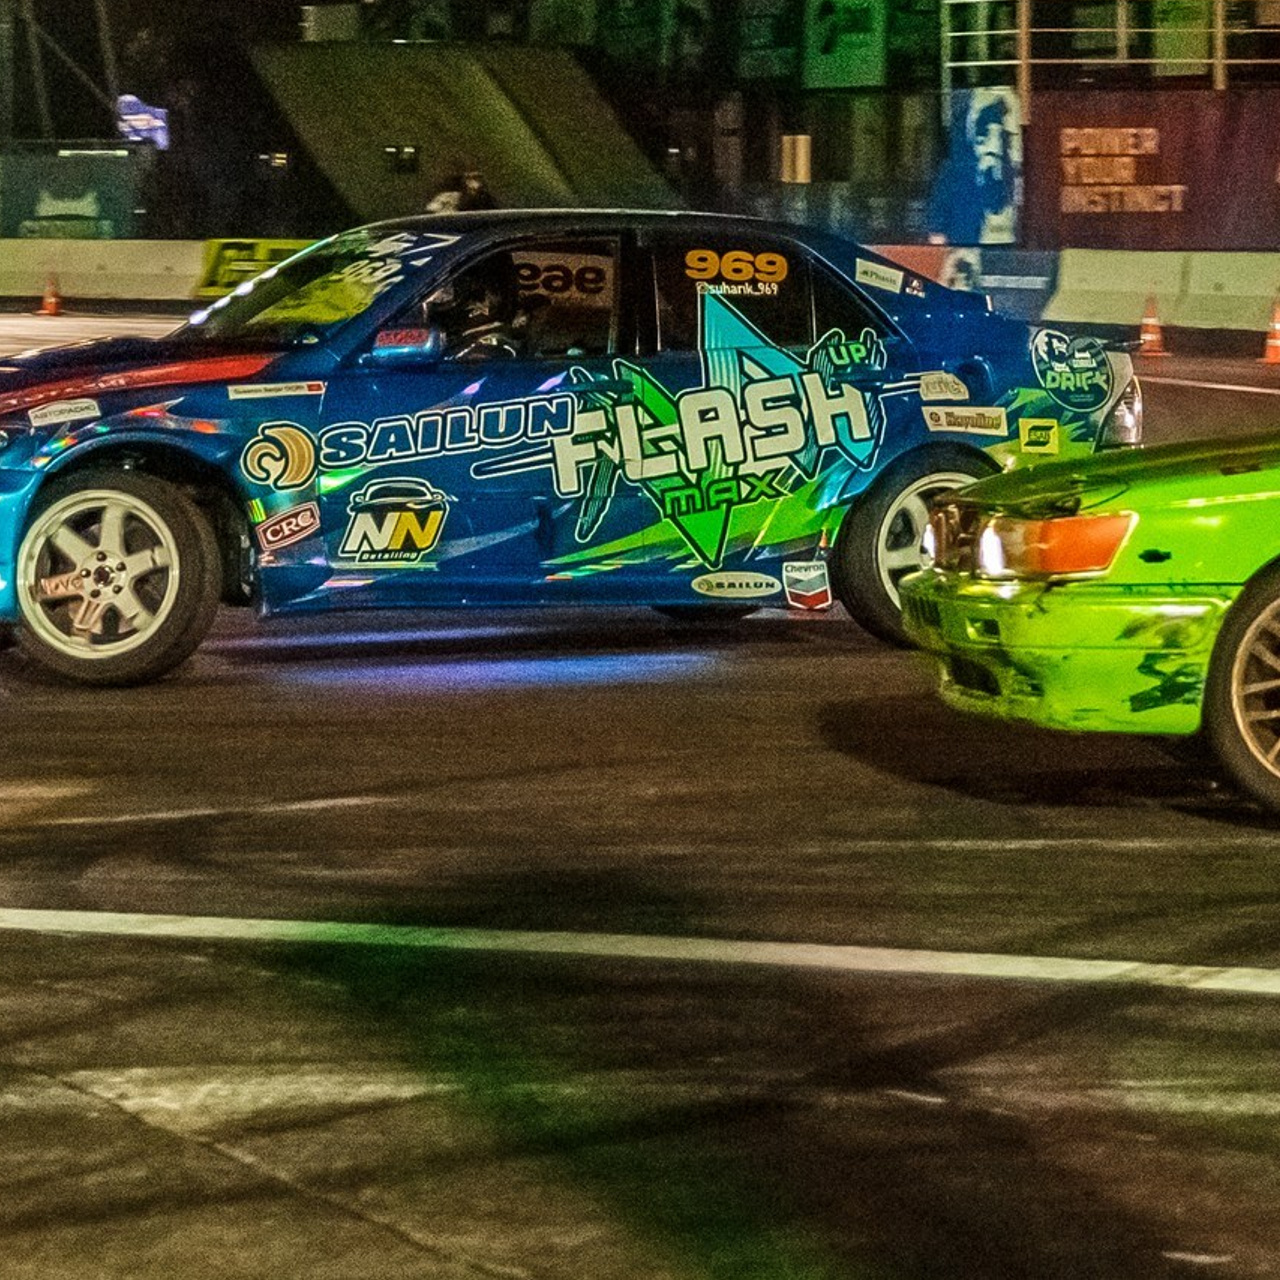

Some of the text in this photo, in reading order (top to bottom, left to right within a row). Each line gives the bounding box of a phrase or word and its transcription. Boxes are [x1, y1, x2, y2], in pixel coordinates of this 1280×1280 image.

[685, 249, 788, 282] 969
[318, 395, 575, 467] SAILUN
[552, 372, 872, 494] FLASH
[663, 471, 779, 517] MAX
[266, 511, 316, 543] CRC
[344, 510, 443, 551] NN
[361, 551, 418, 561] Detailing
[785, 564, 825, 574] Chevron
[715, 581, 776, 589] SAILUN
